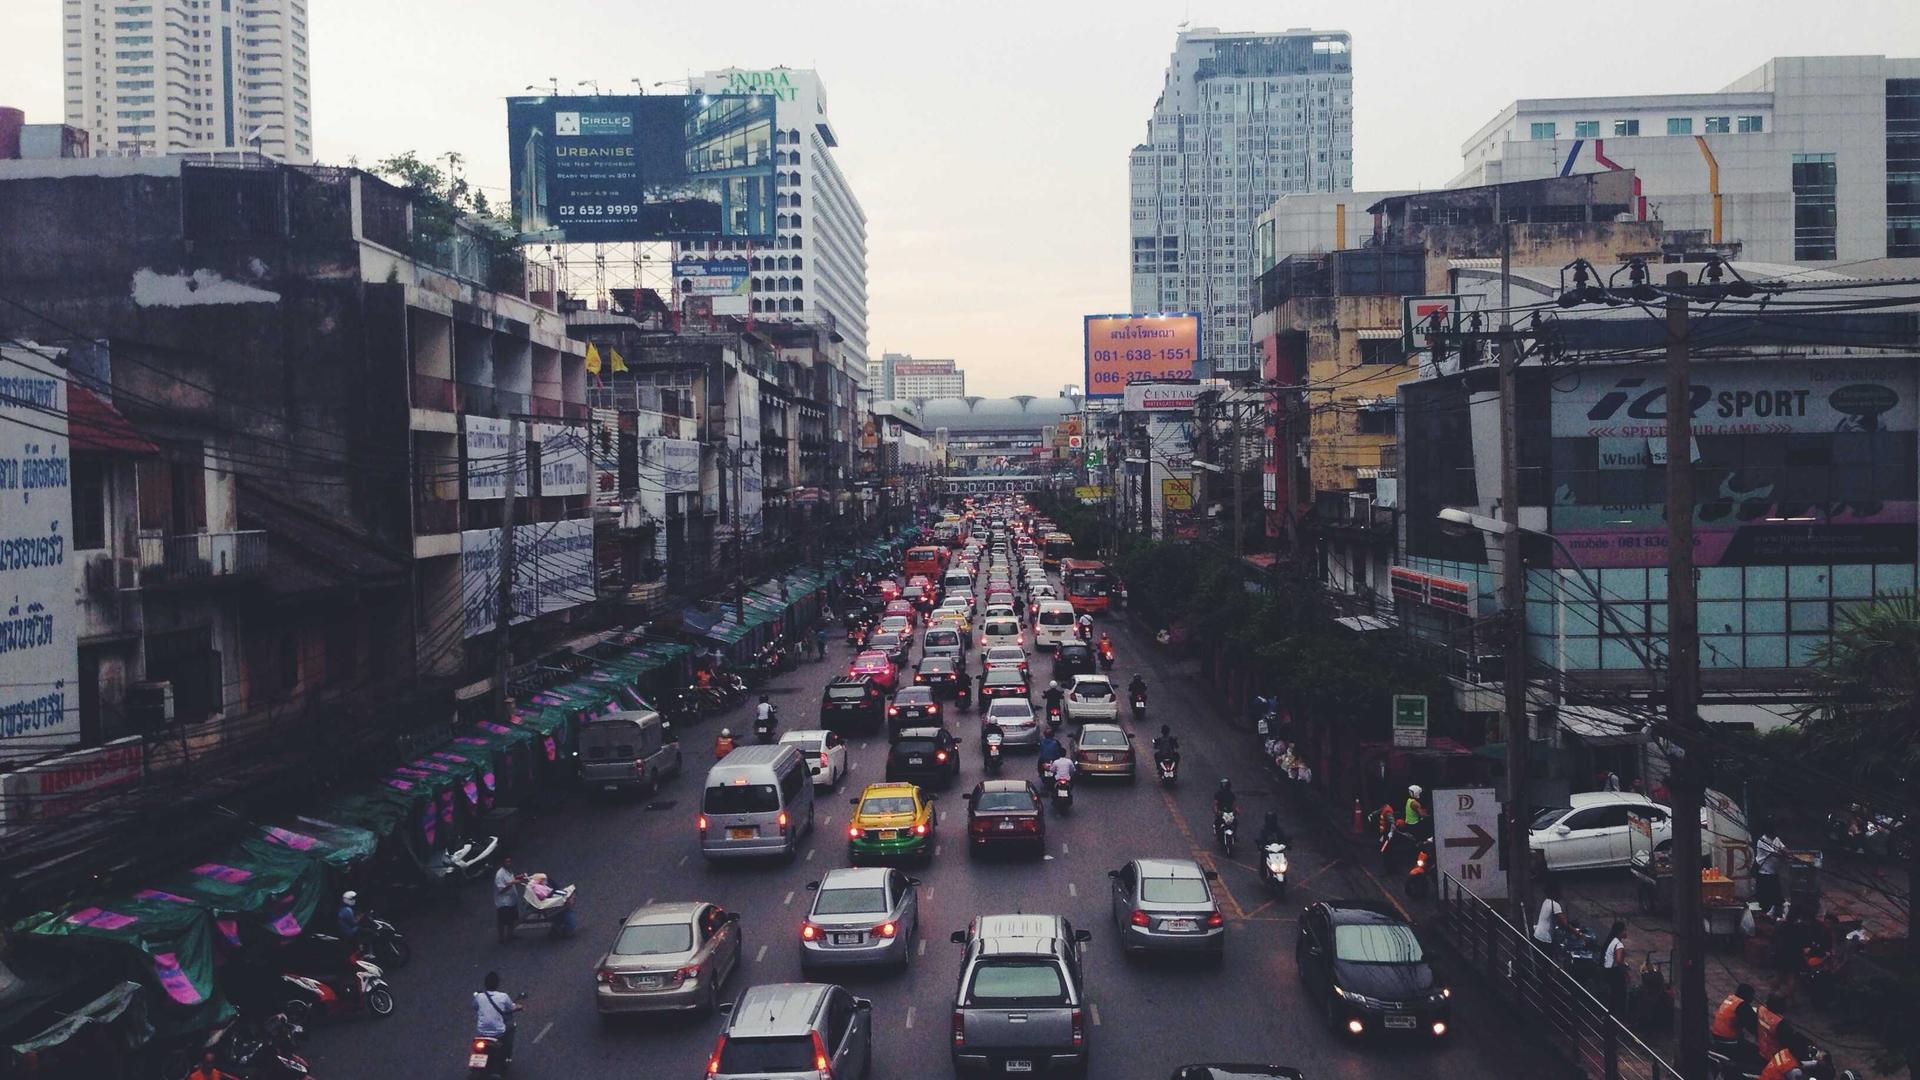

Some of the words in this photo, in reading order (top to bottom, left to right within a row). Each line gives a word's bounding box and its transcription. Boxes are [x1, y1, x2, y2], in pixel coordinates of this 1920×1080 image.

[729, 71, 790, 87] INDRA
[559, 205, 576, 216] 02
[579, 205, 603, 216] 652
[607, 205, 638, 215] 9999
[1110, 325, 1175, 340] สนใจโฆษณา
[1094, 348, 1191, 362] 081-638-1551
[1094, 369, 1193, 383] 086-376-1522
[1717, 389, 1810, 418] SPORT
[1569, 538, 1609, 550] mobile
[1461, 863, 1482, 880] IN
